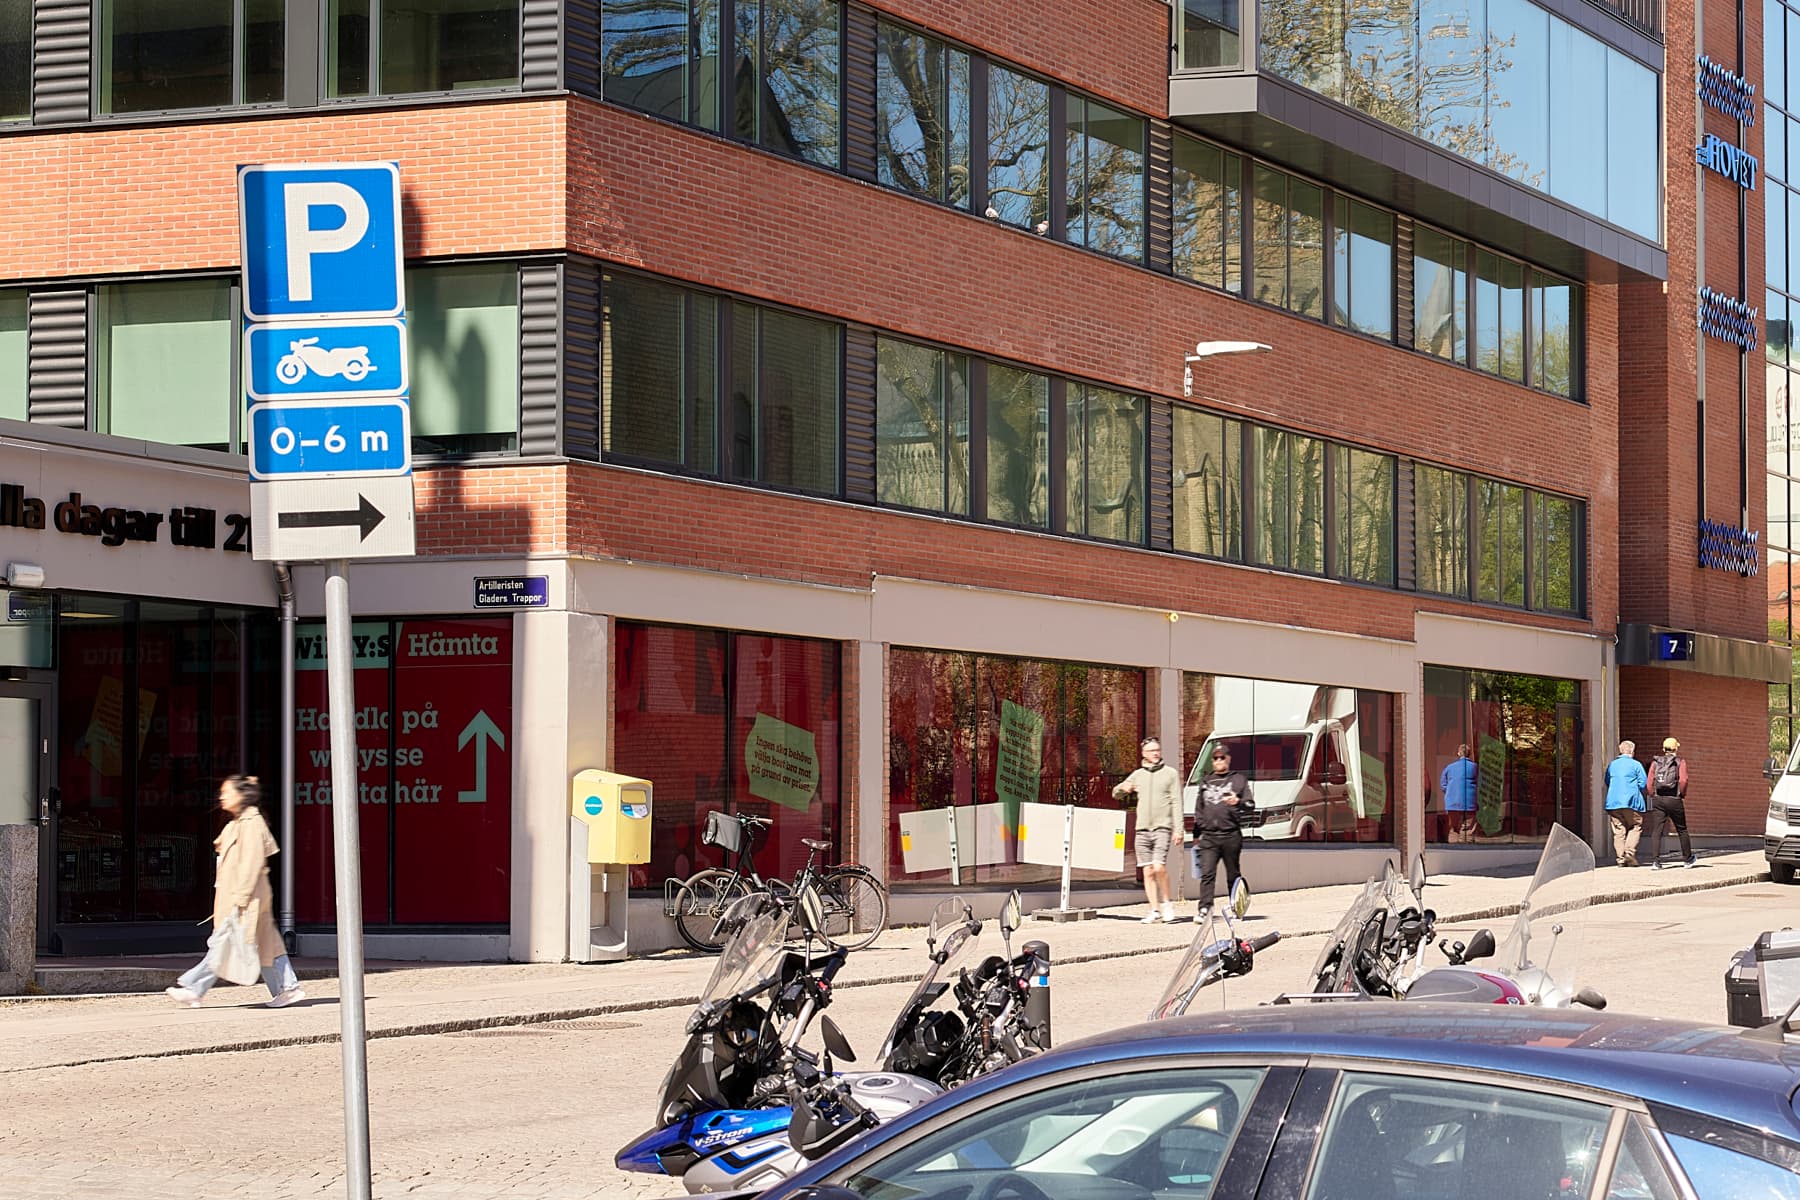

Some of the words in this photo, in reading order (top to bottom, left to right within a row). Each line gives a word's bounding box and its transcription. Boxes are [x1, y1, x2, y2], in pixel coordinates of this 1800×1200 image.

[284, 182, 370, 301] P
[361, 430, 389, 452] m
[54, 492, 163, 546] dagar
[169, 506, 216, 548] till
[479, 580, 524, 590] Artilleristen
[479, 593, 508, 603] Gladers
[511, 593, 543, 604] Trappor
[407, 632, 498, 657] Hämta
[402, 701, 439, 734] på
[756, 736, 775, 750] Ingen
[776, 745, 788, 756] ska
[789, 748, 812, 765] behöva
[751, 763, 760, 774] på
[761, 767, 781, 782] grund
[783, 774, 790, 785] av
[772, 755, 785, 768] bort
[786, 761, 797, 774] bra
[798, 766, 812, 779] mat
[295, 780, 388, 806] Häta
[395, 778, 442, 805] här
